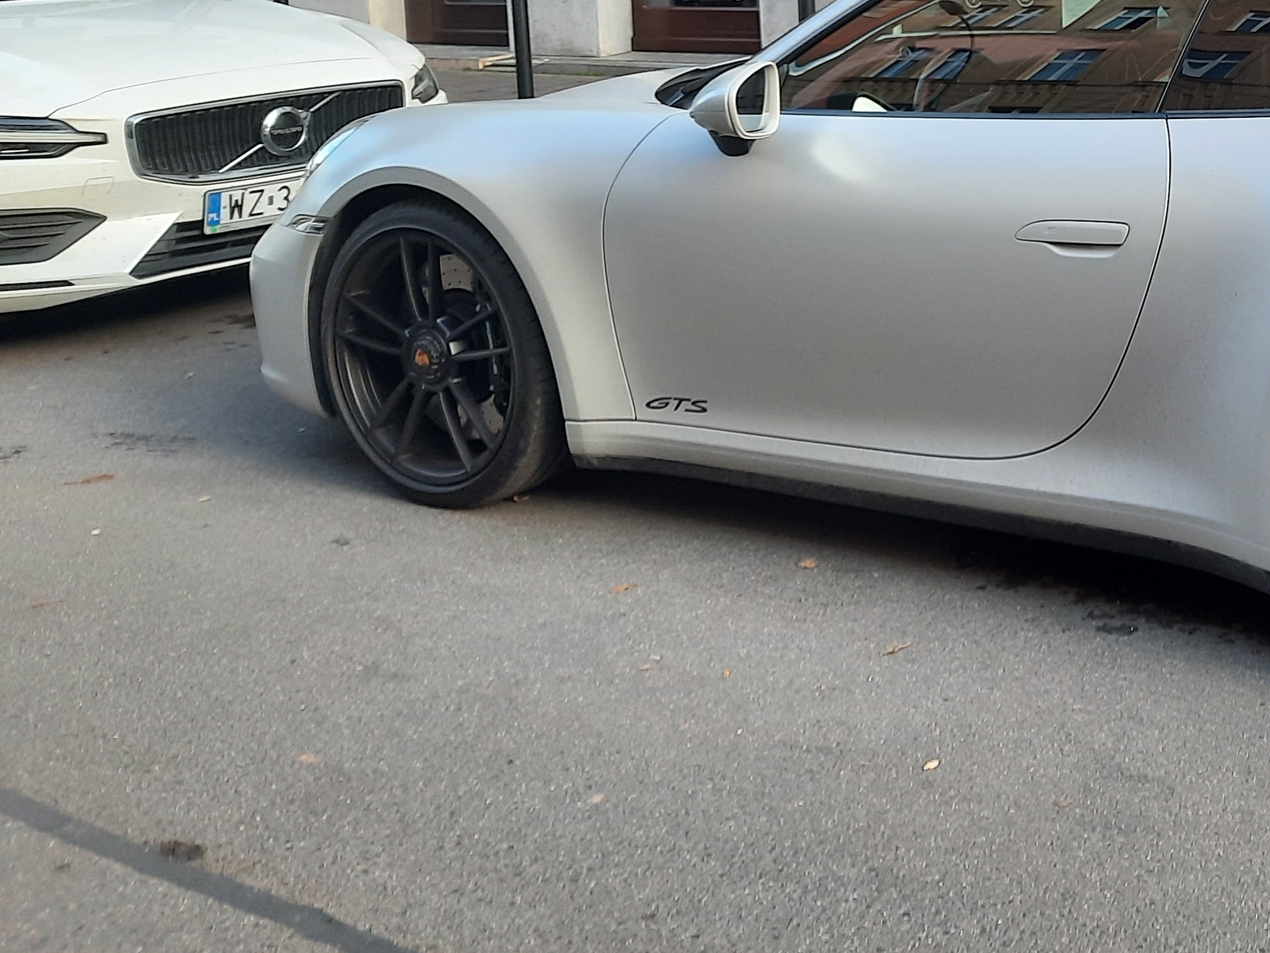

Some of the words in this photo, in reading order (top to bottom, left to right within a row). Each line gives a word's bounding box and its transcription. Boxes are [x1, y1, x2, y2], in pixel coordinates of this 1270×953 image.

[229, 189, 264, 220] WZ
[208, 212, 219, 222] PL
[645, 396, 708, 413] GTS
